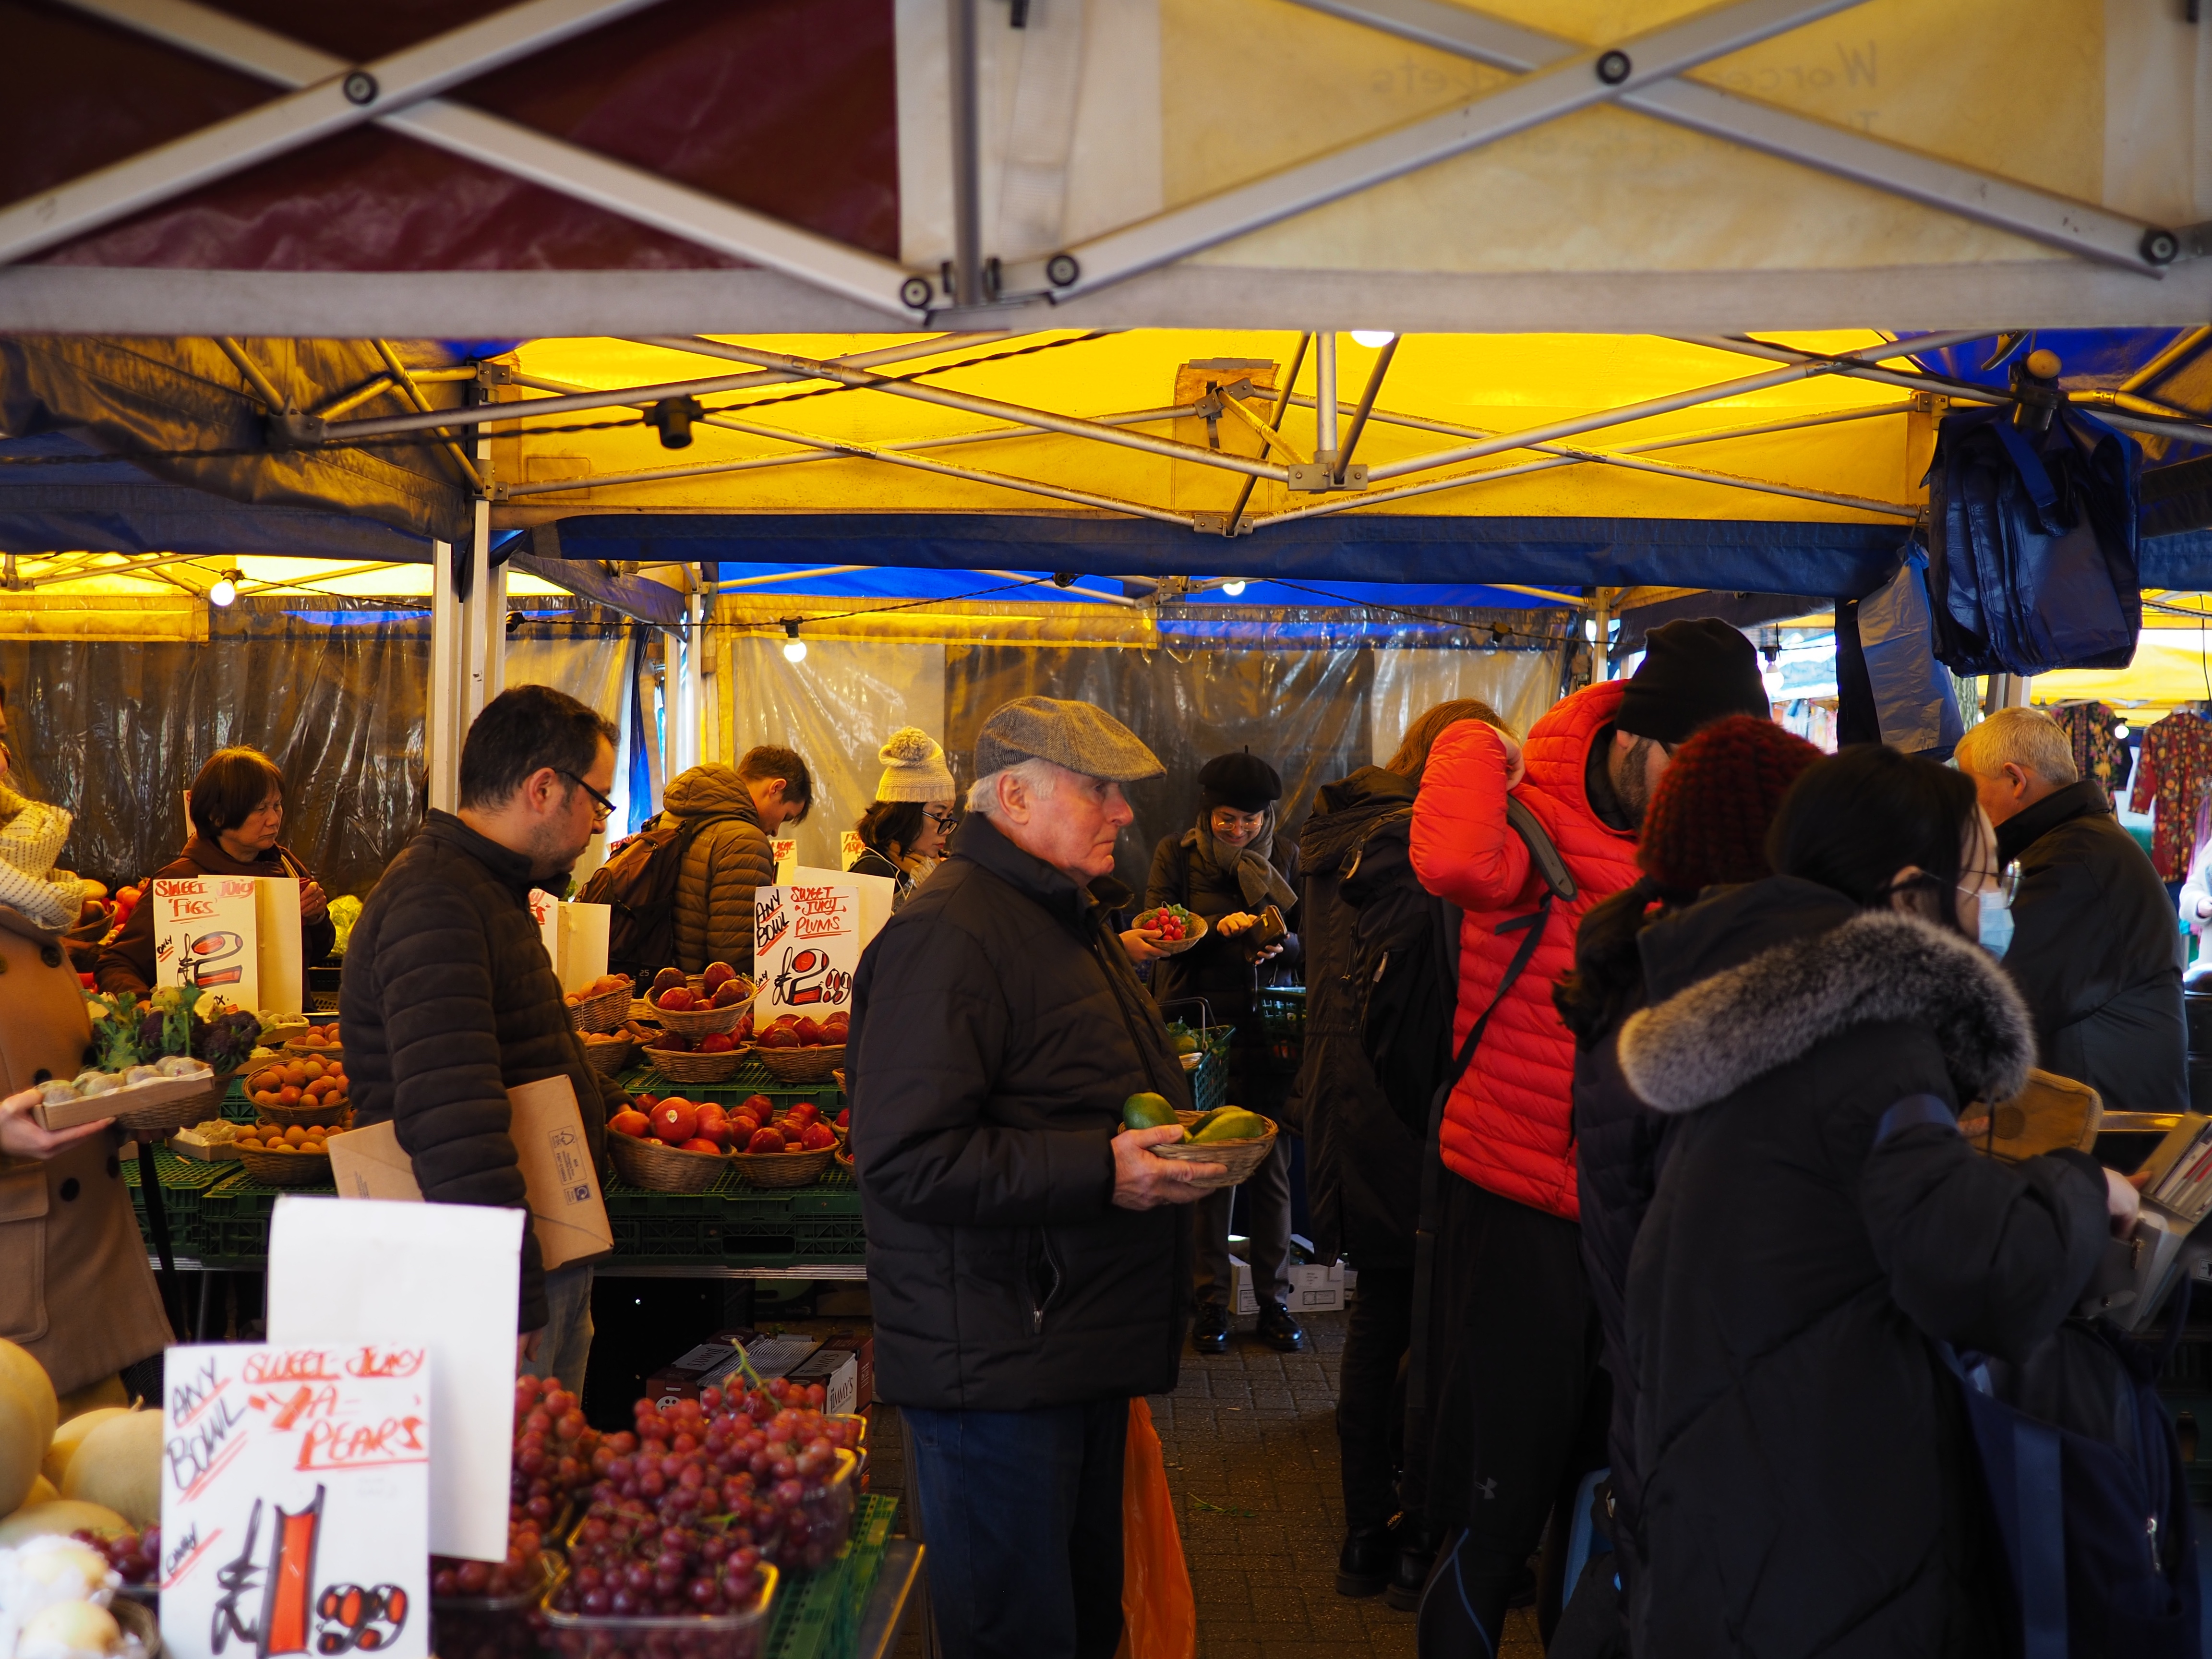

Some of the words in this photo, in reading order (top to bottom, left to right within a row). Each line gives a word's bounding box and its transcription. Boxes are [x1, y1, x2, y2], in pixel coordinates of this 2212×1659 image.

[155, 880, 206, 897] SWEET
[791, 887, 834, 902] SWEET
[756, 889, 780, 928] ANY
[795, 916, 840, 936] PLUMS
[156, 935, 172, 954] ONLY
[757, 912, 790, 948] BOWL
[173, 1357, 217, 1427] ANY
[830, 1377, 853, 1413] JIMMY'S
[166, 1397, 248, 1490] BOWL
